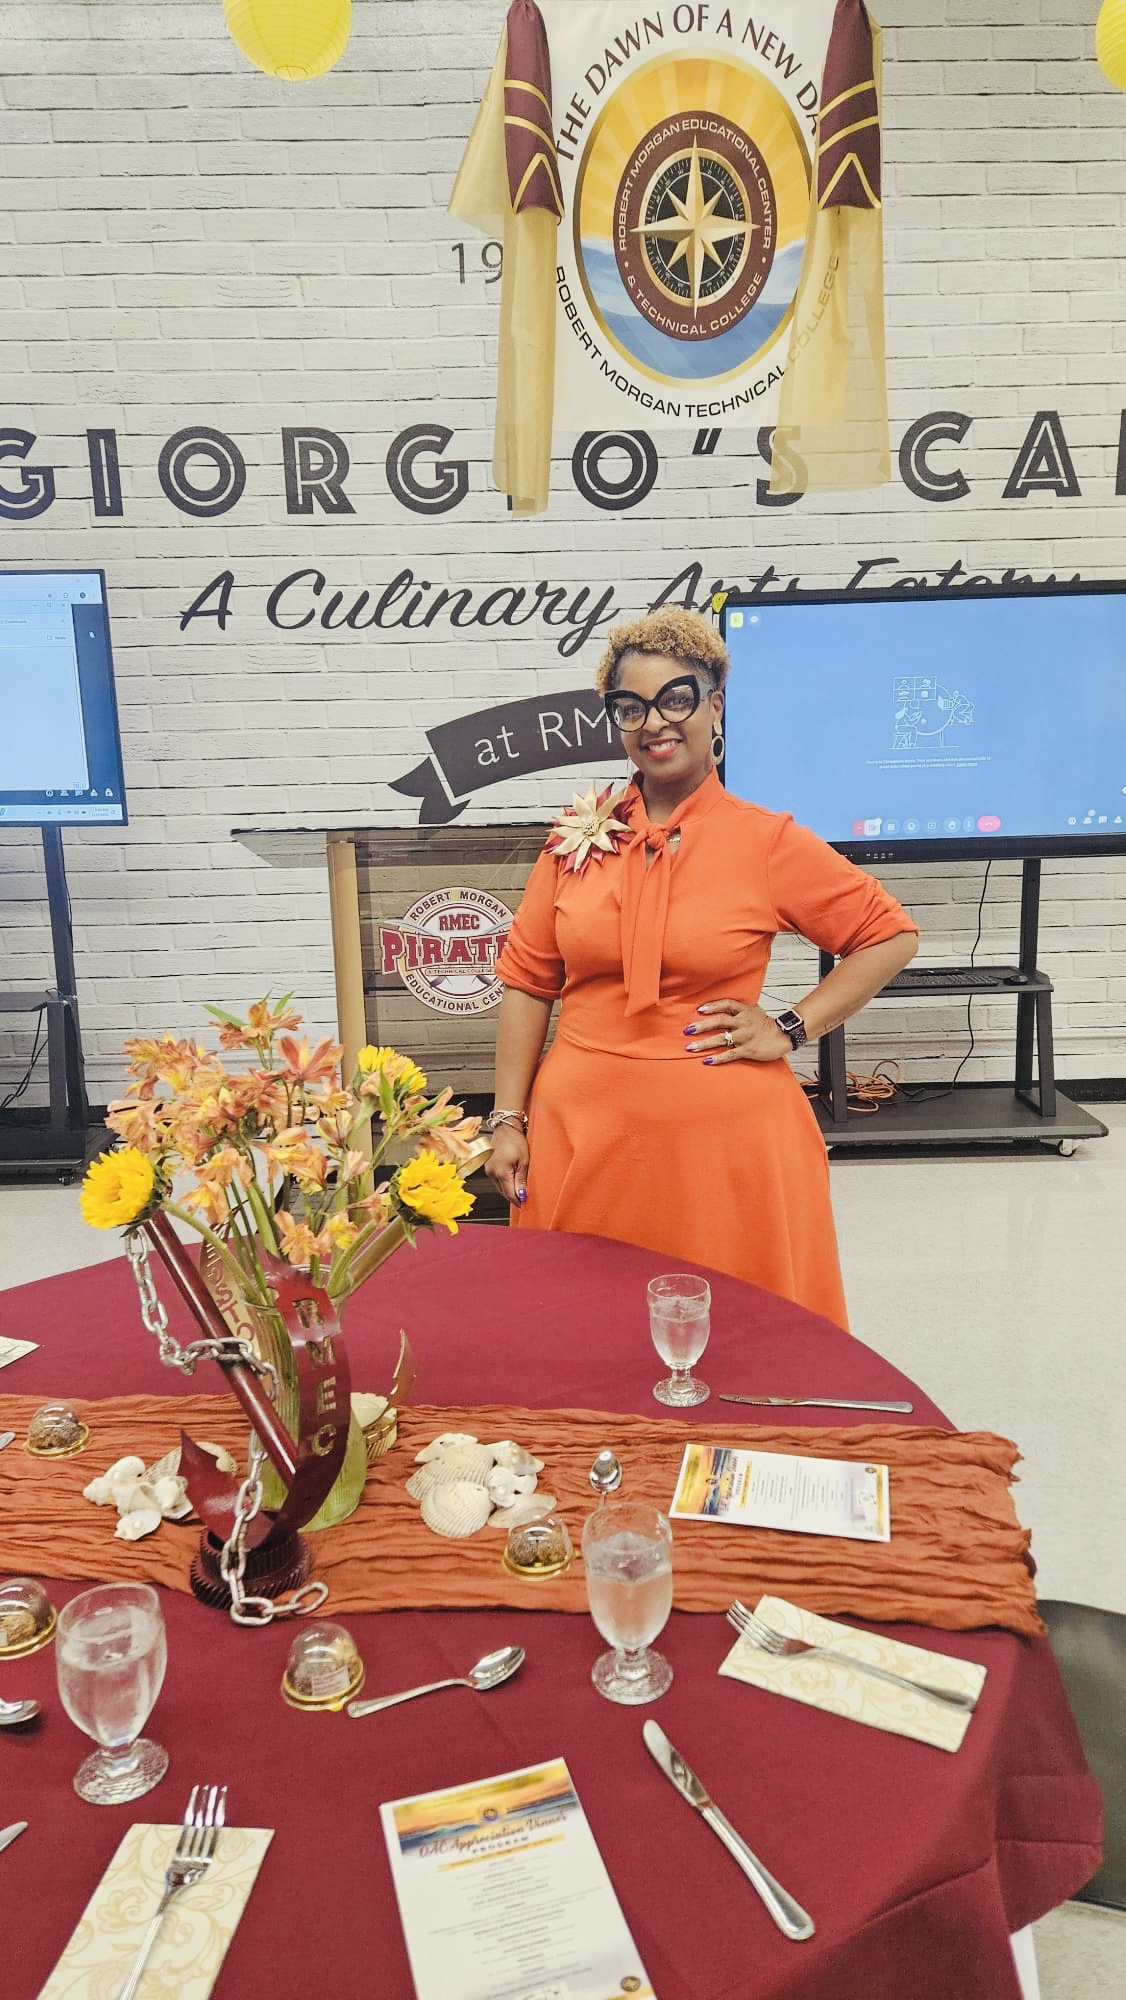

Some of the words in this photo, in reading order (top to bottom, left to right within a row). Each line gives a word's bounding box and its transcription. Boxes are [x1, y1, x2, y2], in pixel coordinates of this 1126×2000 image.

[555, 92, 592, 161] THE
[584, 11, 664, 96] DAWN
[672, 3, 709, 33] OF
[715, 8, 733, 38] A
[741, 17, 802, 79] NEW
[796, 80, 819, 136] DA
[618, 181, 635, 251] ROBERT
[631, 122, 681, 178] MORGAN
[682, 118, 761, 177] EDUCATIONAL
[757, 177, 773, 250] CENTER
[555, 266, 602, 360] ROBERT
[599, 359, 681, 417] MORGAN
[685, 365, 788, 418] TECHNICAL
[787, 255, 839, 363] COLLEGE
[626, 274, 636, 289] &
[636, 289, 707, 335] TECHNICAL
[710, 273, 763, 331] COLLEGE
[899, 409, 1126, 502] CA
[180, 570, 235, 632] A
[266, 568, 617, 658] Culinary
[474, 725, 520, 766] at
[538, 706, 613, 752] RM
[409, 891, 451, 921] ROBERT
[459, 890, 507, 918] MORGAN
[438, 913, 480, 931] RMEC
[405, 973, 480, 1011] EDUCATIONAL
